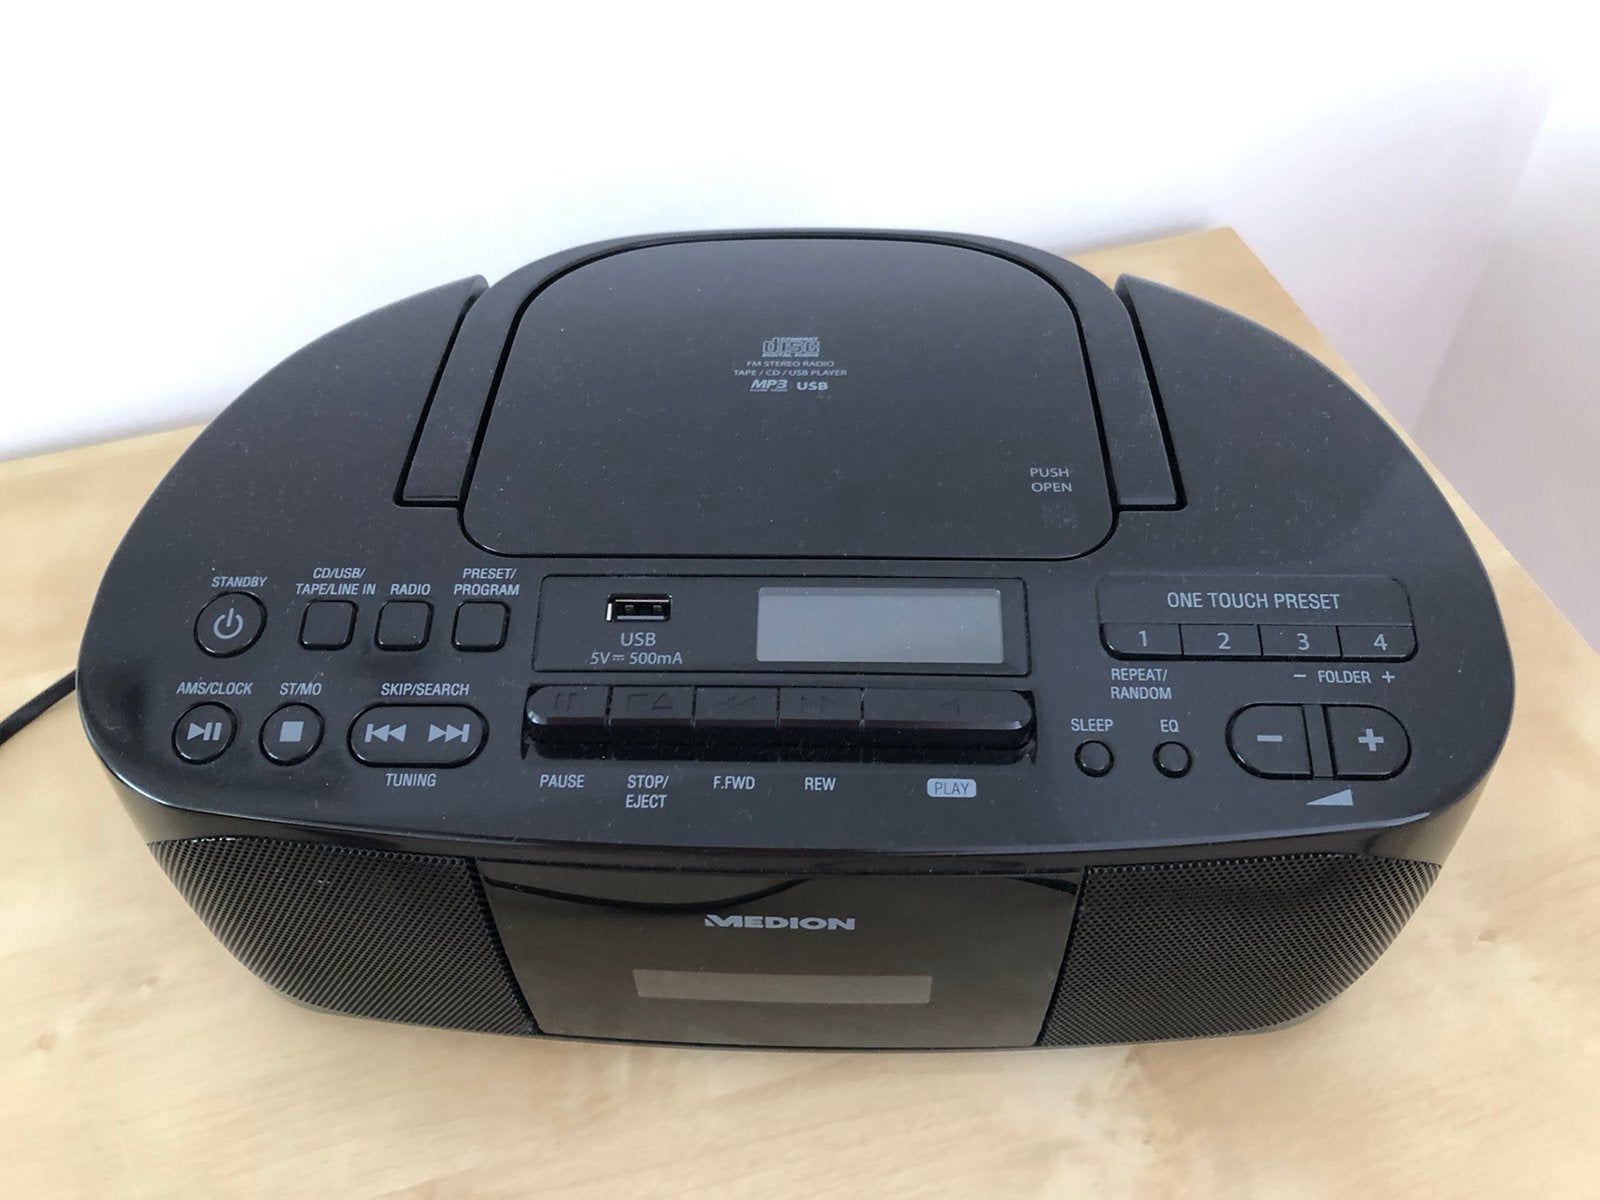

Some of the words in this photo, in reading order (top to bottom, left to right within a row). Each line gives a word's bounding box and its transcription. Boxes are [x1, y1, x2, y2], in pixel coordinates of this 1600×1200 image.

[734, 369, 757, 377] TAPE
[765, 369, 781, 377] CD
[788, 369, 809, 377] USB
[810, 369, 848, 377] PLAYER
[750, 379, 788, 390] MP3
[796, 380, 829, 392] USB
[1029, 467, 1071, 478] PUSH
[1030, 482, 1073, 494] OPEN
[312, 567, 367, 581] CD/USB/
[461, 567, 517, 581] PRESET/
[211, 575, 268, 589] STANDBY
[295, 583, 360, 596] TAPE/LINE
[361, 583, 377, 596] IN
[389, 583, 432, 596] RADIO
[453, 583, 520, 597] PROGRAM
[1166, 591, 1204, 610] ONE
[1206, 592, 1269, 610] TOUCH
[1274, 592, 1341, 611] PRESET
[619, 631, 657, 648] USB
[1137, 630, 1149, 648] 1
[1216, 632, 1232, 650] 2
[1297, 632, 1311, 651] 3
[1372, 633, 1389, 652] 4
[628, 651, 684, 666] 500mA
[1110, 667, 1169, 682] REPEAT/
[1317, 669, 1372, 685] FOLDER
[176, 681, 254, 696] AMS/CLOCK
[279, 682, 323, 697] ST/MO
[380, 682, 471, 698] SKIP/SEARCH
[1110, 685, 1173, 701] RANDOM
[1070, 717, 1114, 733] SLEEP
[1159, 718, 1179, 734] EQ
[385, 773, 438, 788] TUNING
[539, 773, 585, 790] PAUSE
[626, 773, 669, 790] STOP/
[712, 774, 756, 791] F.FWD
[803, 776, 837, 792] REW
[933, 780, 970, 796] PLAY
[625, 794, 668, 810] EJECT
[703, 914, 856, 931] MEDION
